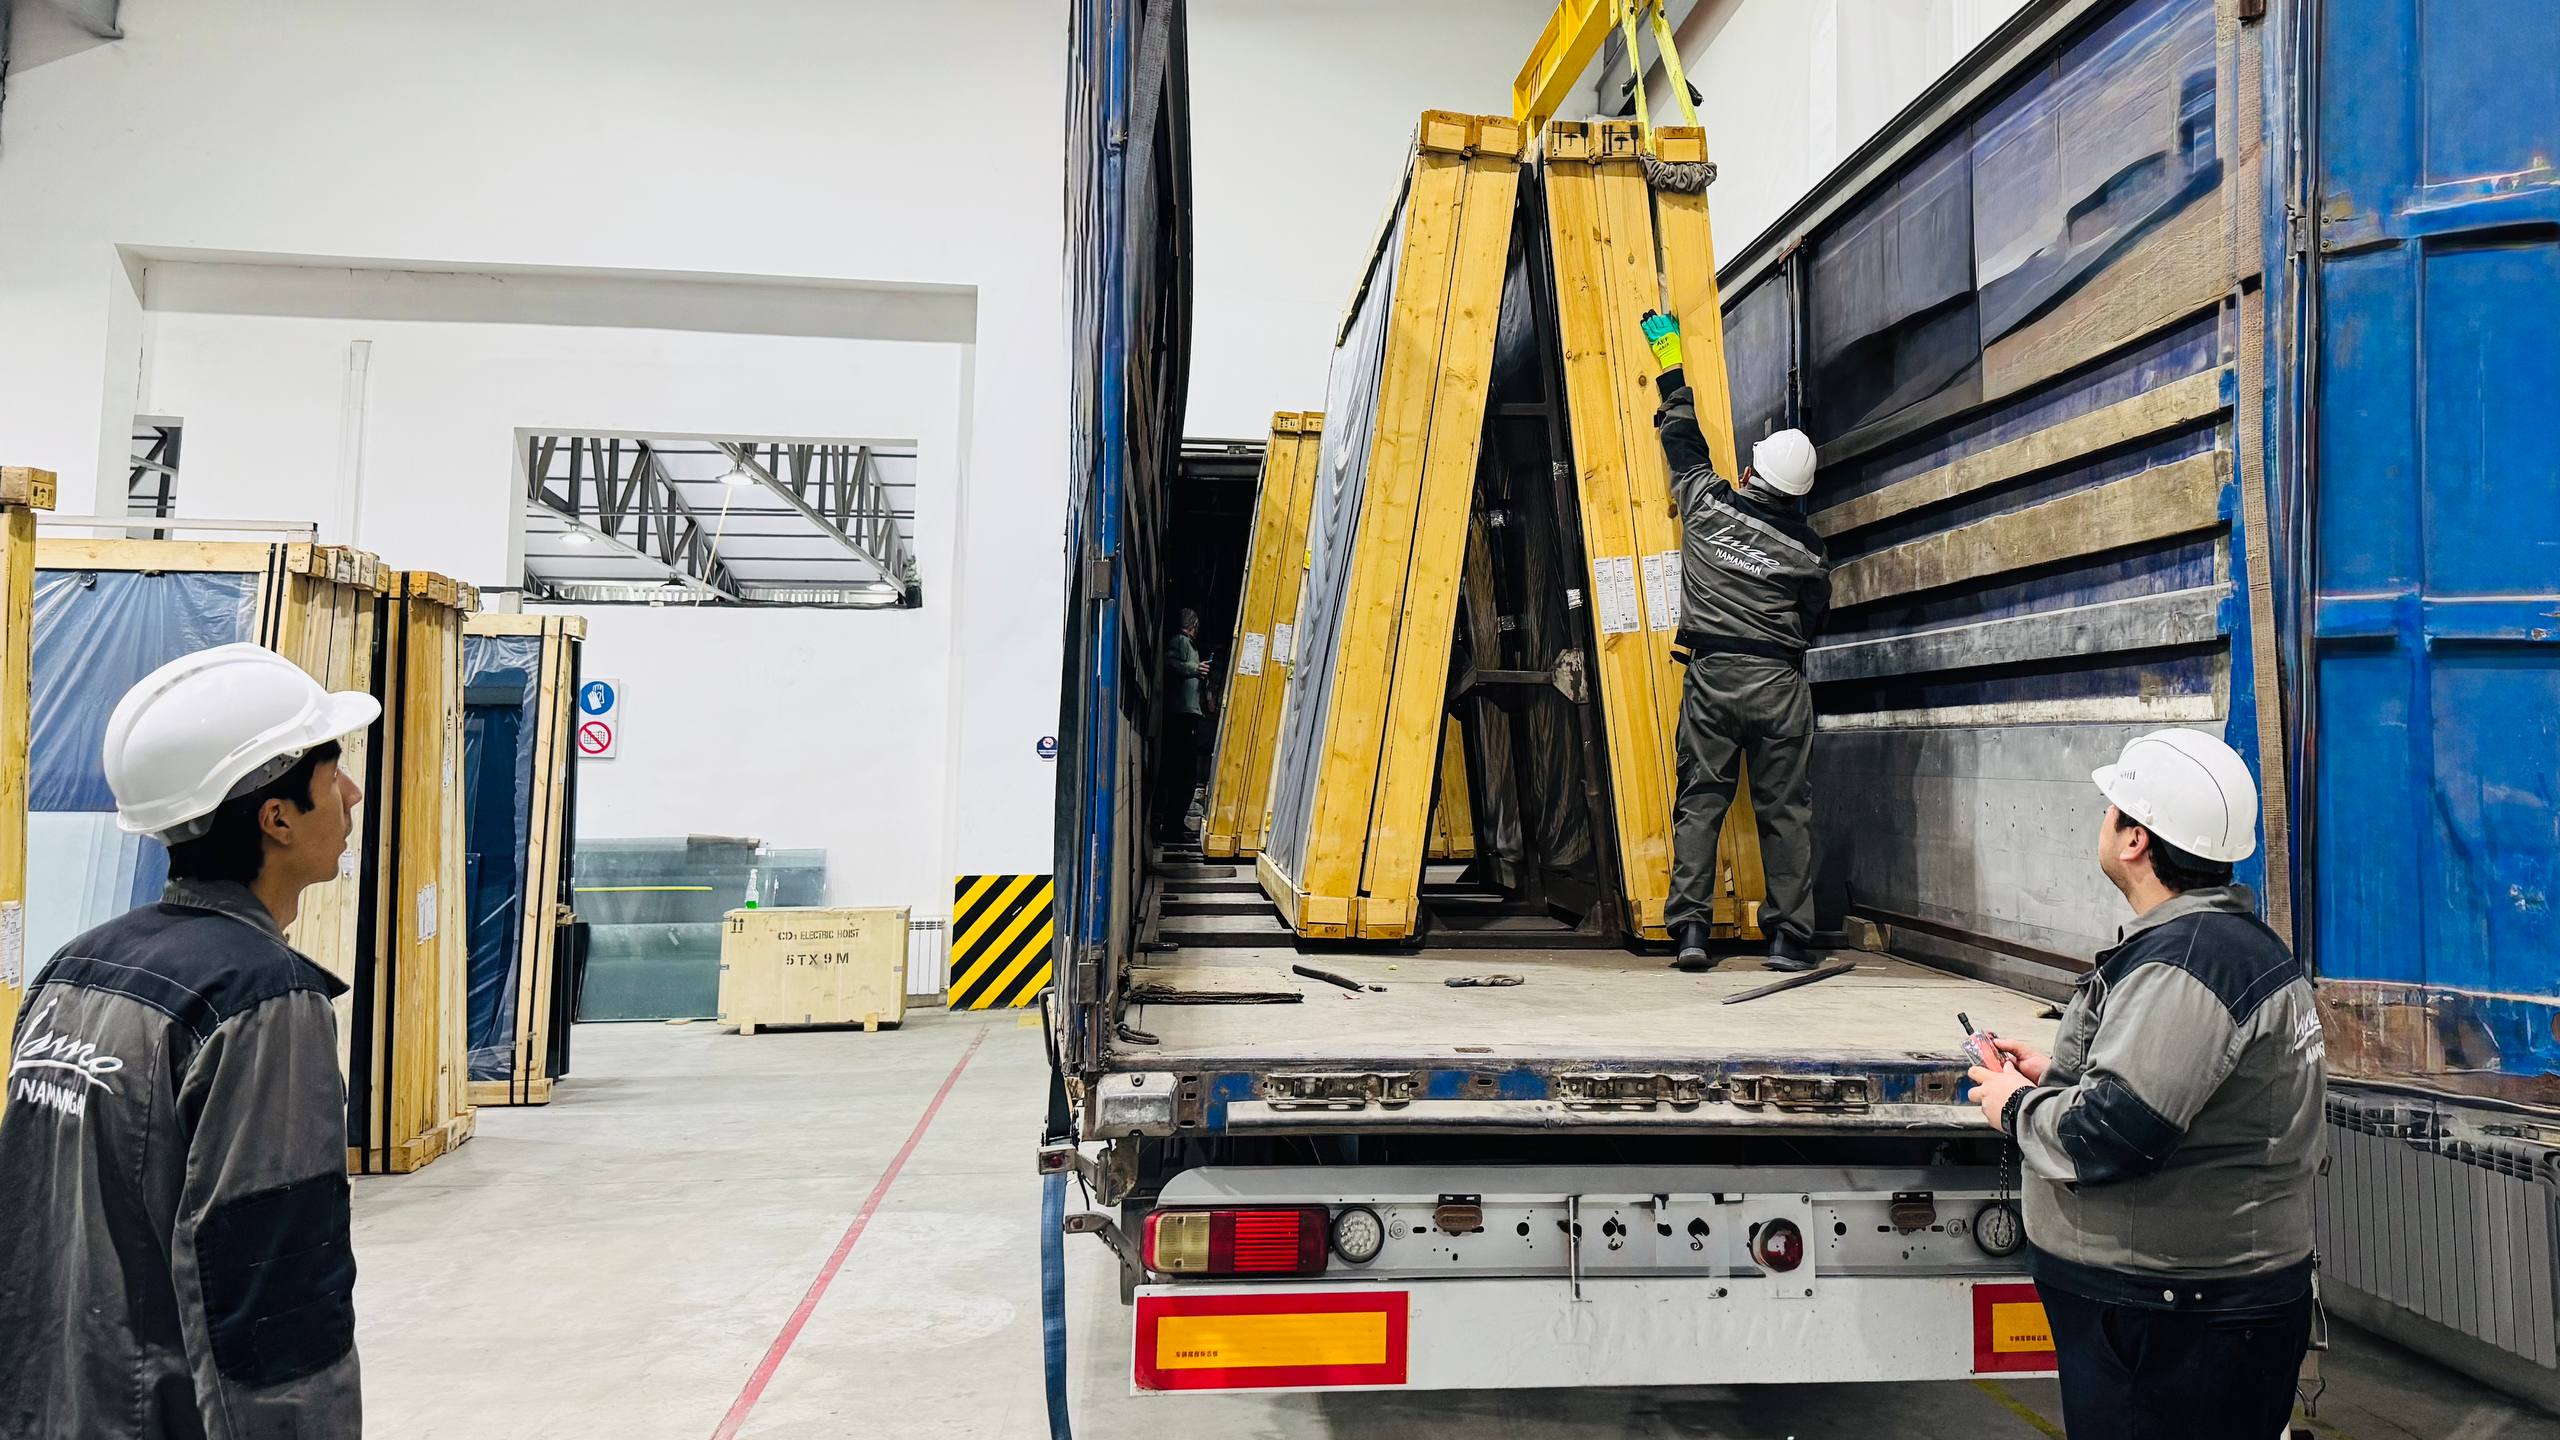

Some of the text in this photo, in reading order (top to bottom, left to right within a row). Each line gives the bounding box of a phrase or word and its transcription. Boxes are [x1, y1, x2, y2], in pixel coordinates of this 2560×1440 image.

[1715, 548, 1762, 576] NAMANGAN
[800, 930, 833, 940] ELECTRIC
[837, 928, 860, 939] HOIST
